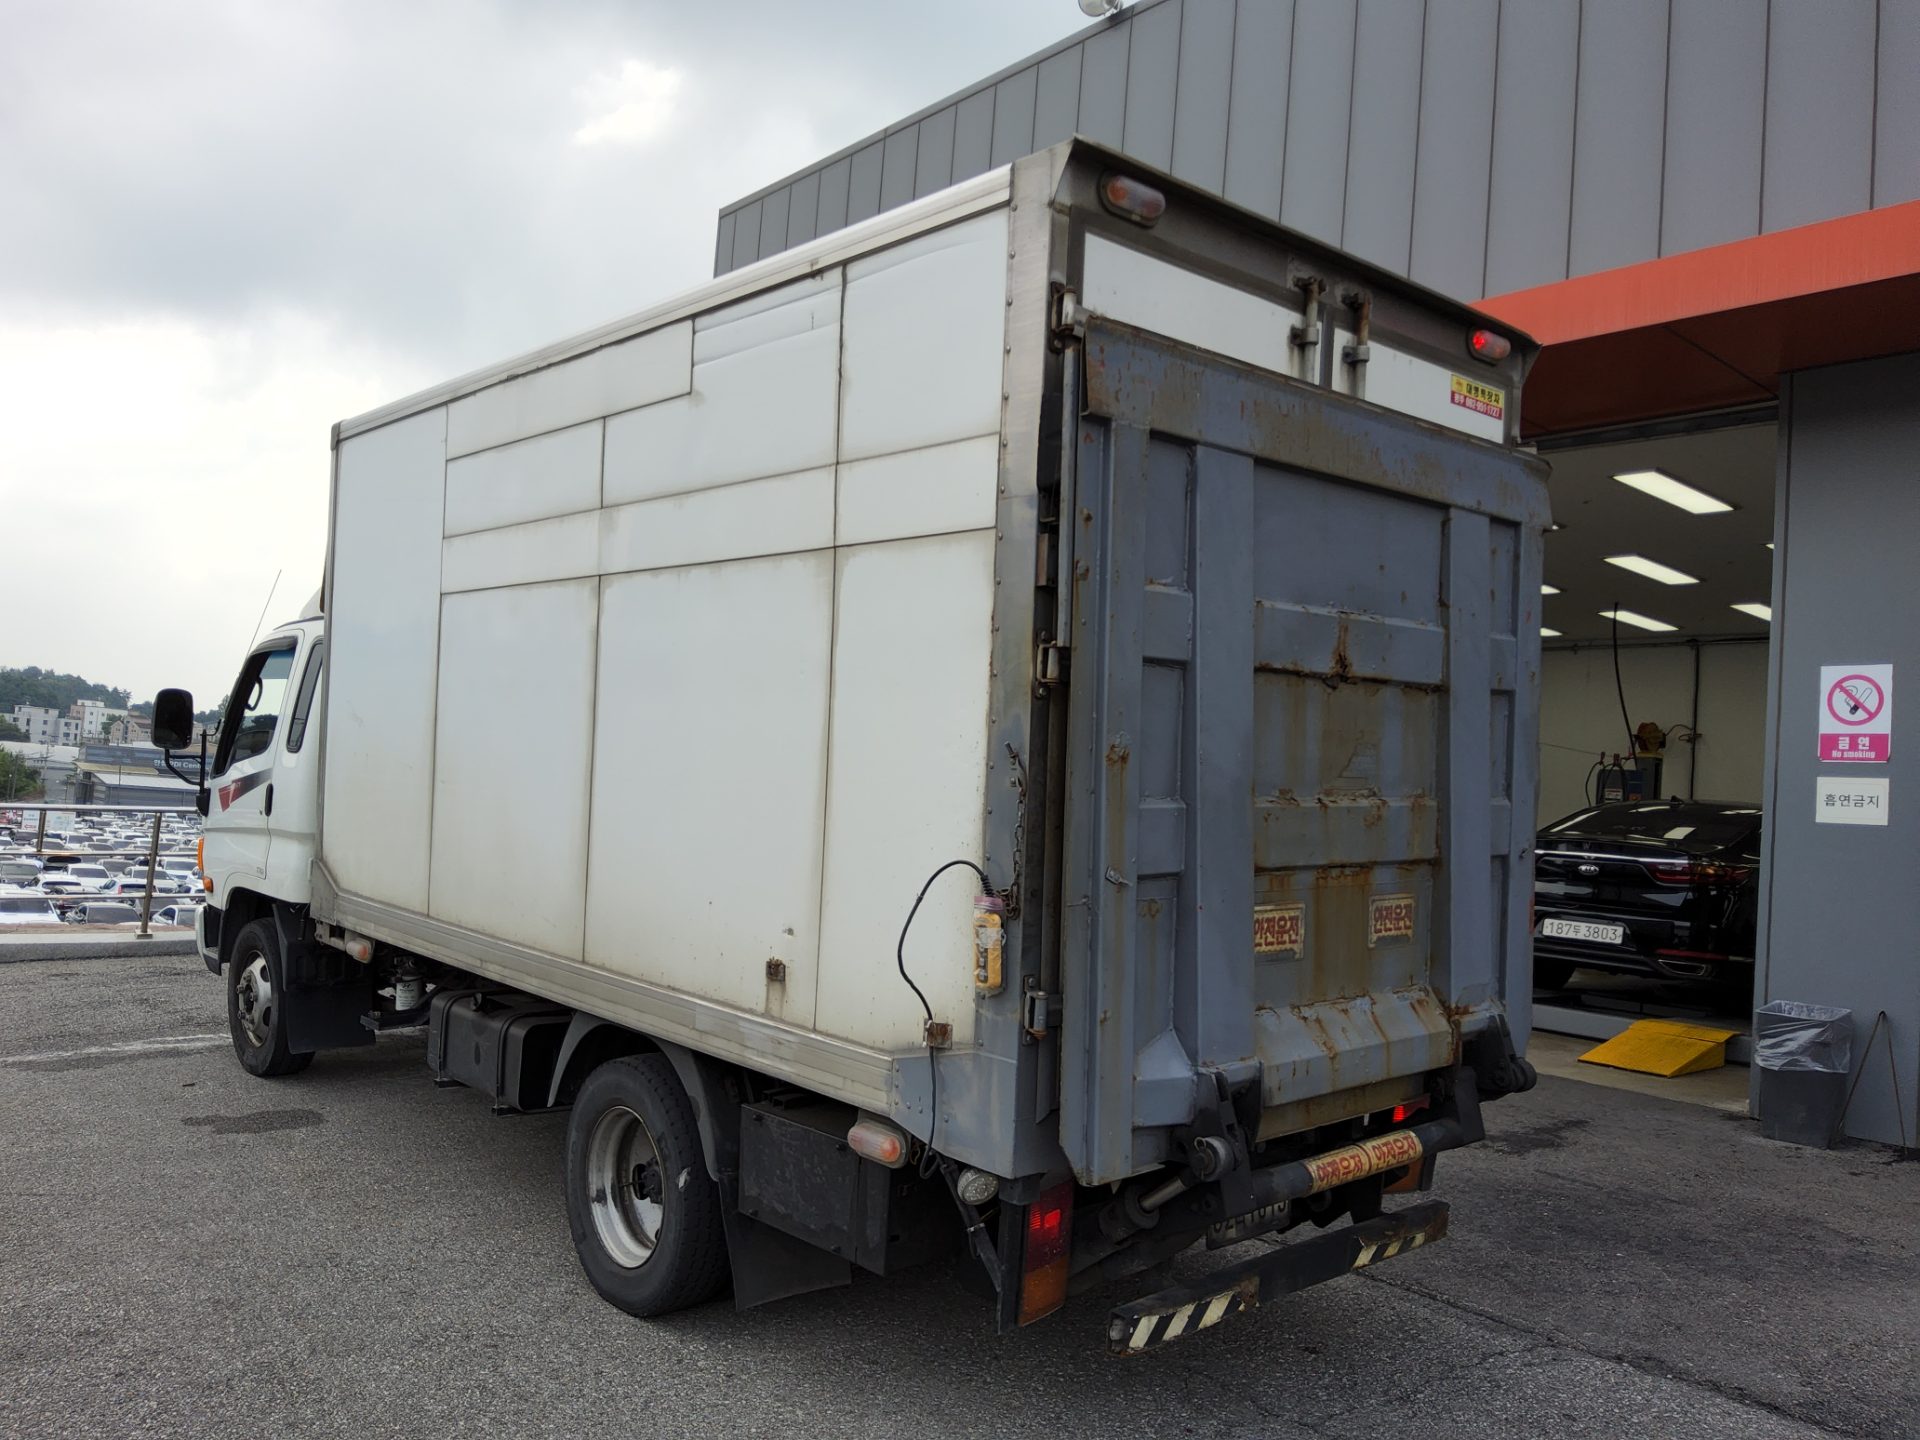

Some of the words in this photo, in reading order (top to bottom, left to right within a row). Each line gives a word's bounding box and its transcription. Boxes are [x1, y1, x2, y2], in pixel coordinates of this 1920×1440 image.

[1842, 750, 1876, 759] smoking
[1824, 793, 1880, 809] 흡연금지
[1373, 902, 1413, 934] 안전운전
[1254, 914, 1300, 947] 안전운전
